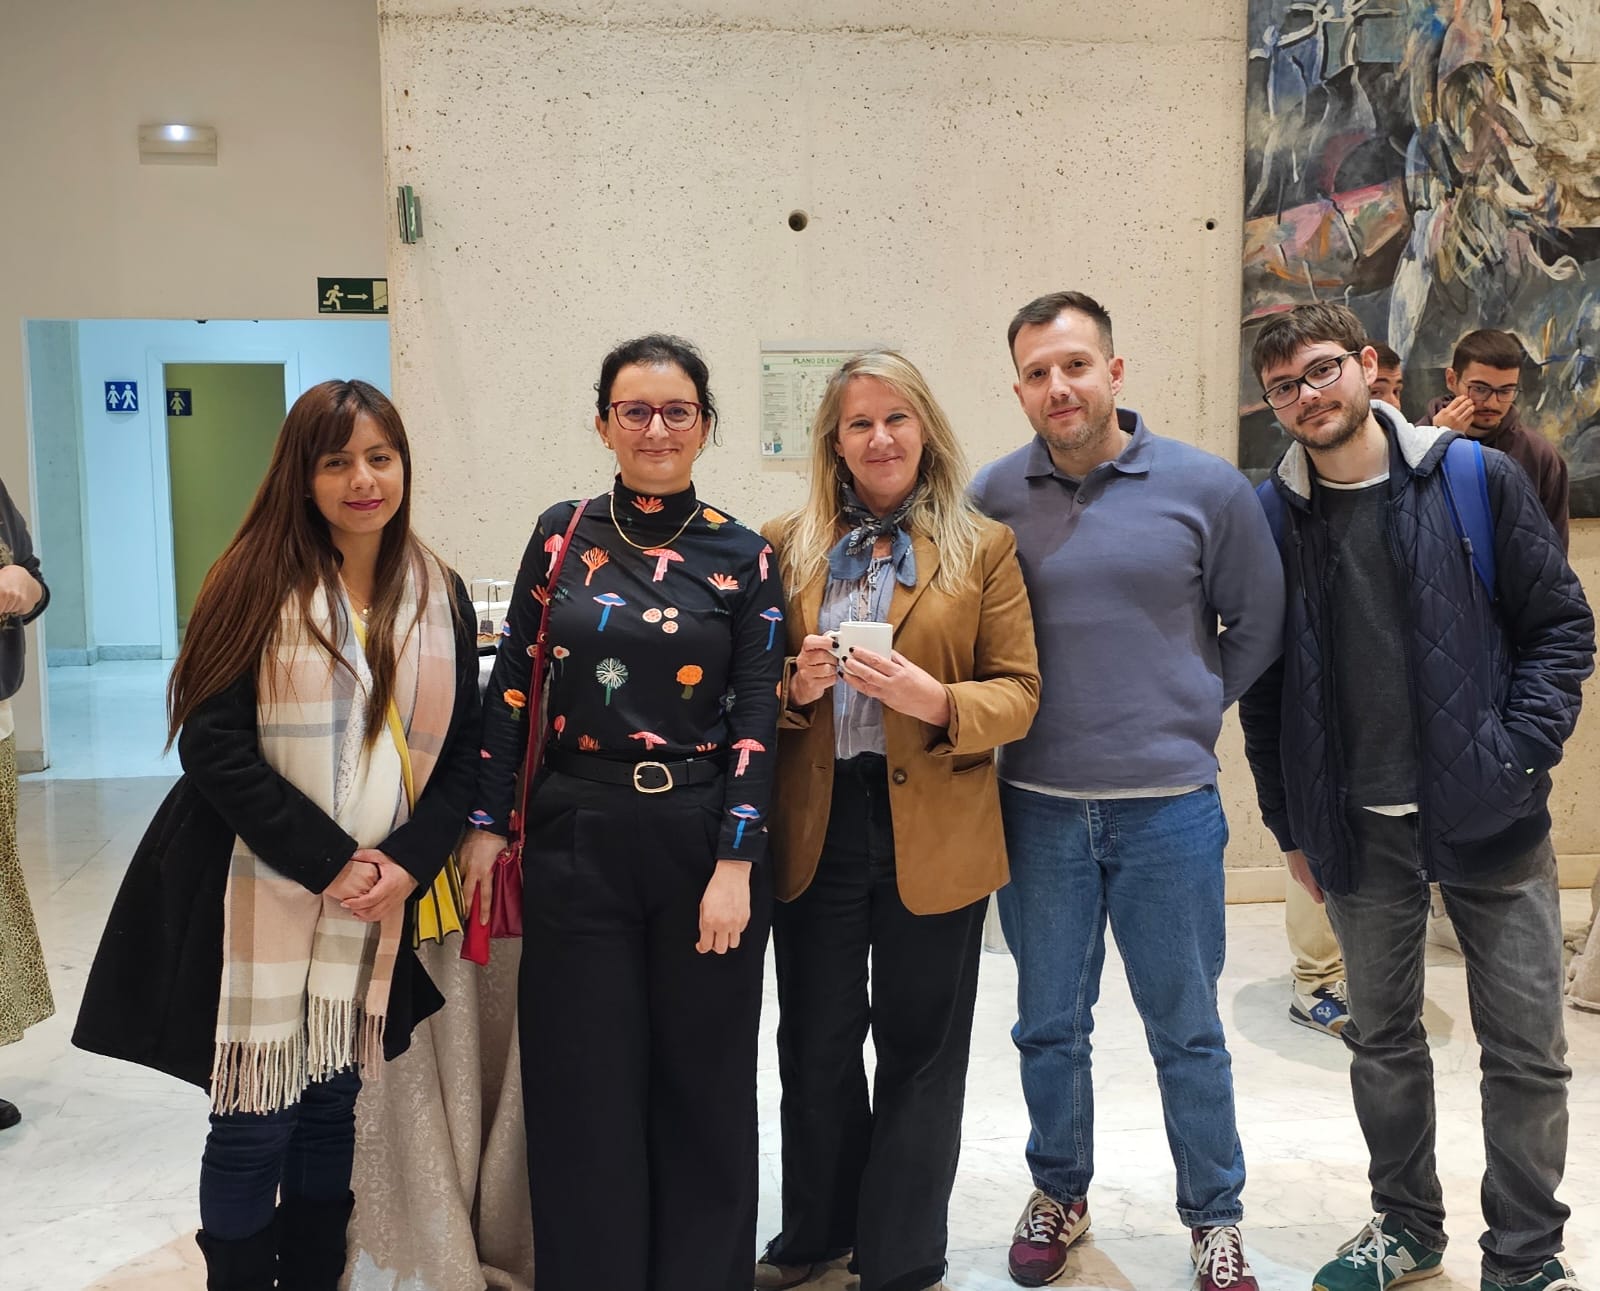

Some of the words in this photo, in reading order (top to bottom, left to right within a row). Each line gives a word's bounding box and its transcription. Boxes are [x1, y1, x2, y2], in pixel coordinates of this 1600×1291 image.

[793, 357, 816, 365] PLANO
[817, 357, 826, 365] DE
[1384, 1246, 1417, 1280] N
